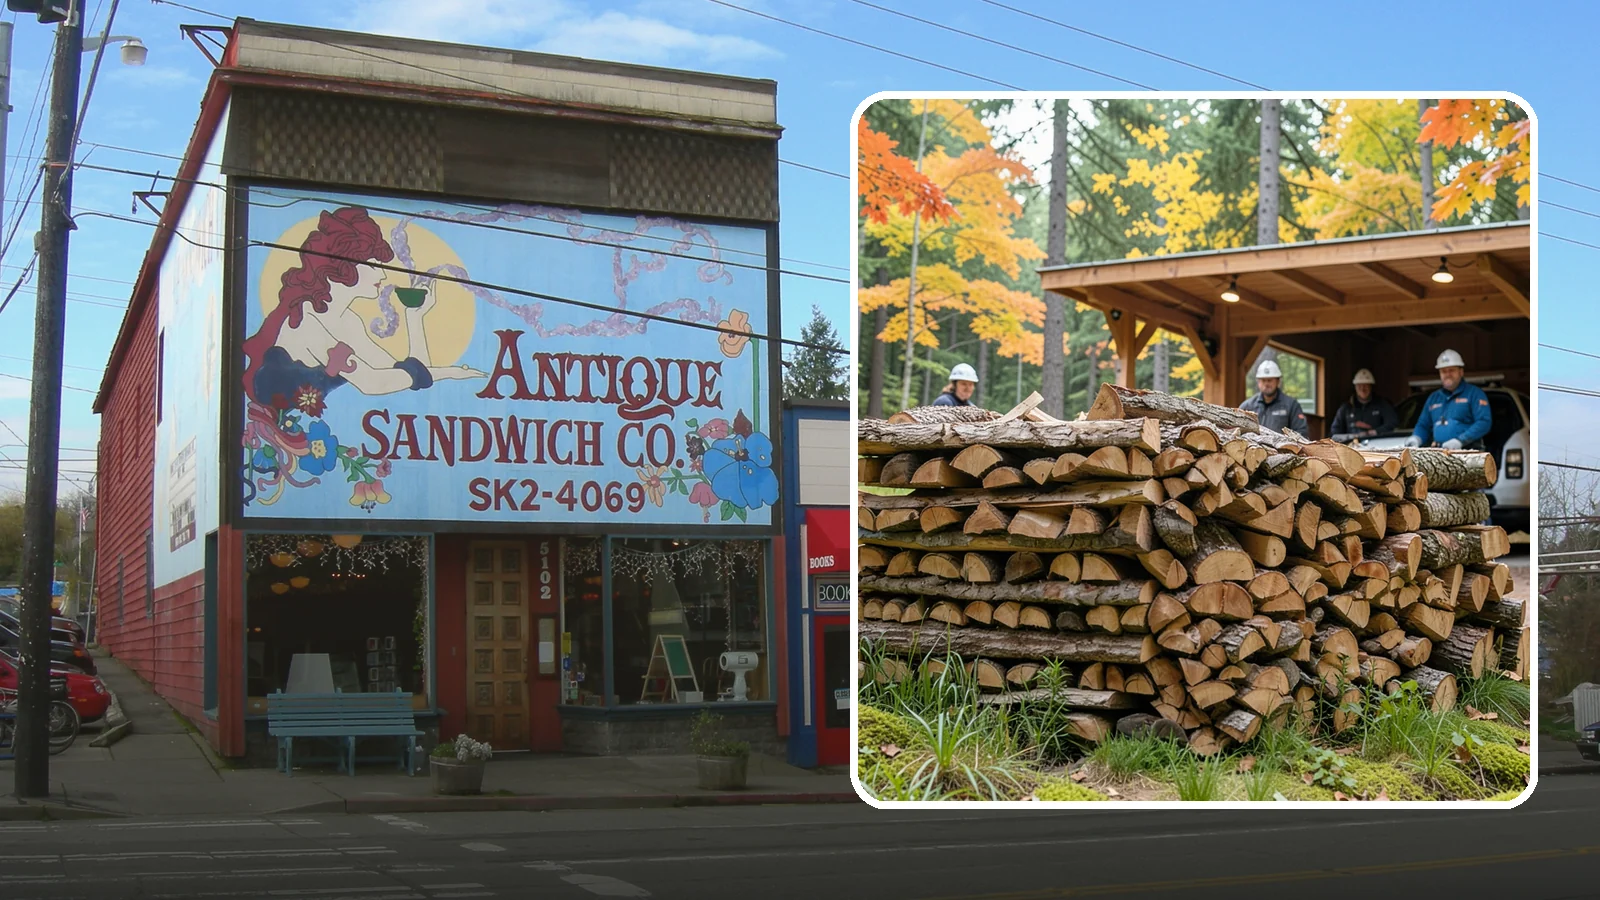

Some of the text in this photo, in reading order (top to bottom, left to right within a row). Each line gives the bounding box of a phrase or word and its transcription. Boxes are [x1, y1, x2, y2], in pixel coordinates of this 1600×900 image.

[476, 329, 723, 420] ANTIQUE
[361, 408, 685, 469] SANDWICH CO.
[468, 478, 646, 513] SK2-4069
[540, 541, 551, 600] 5102
[809, 555, 835, 569] BOOKS
